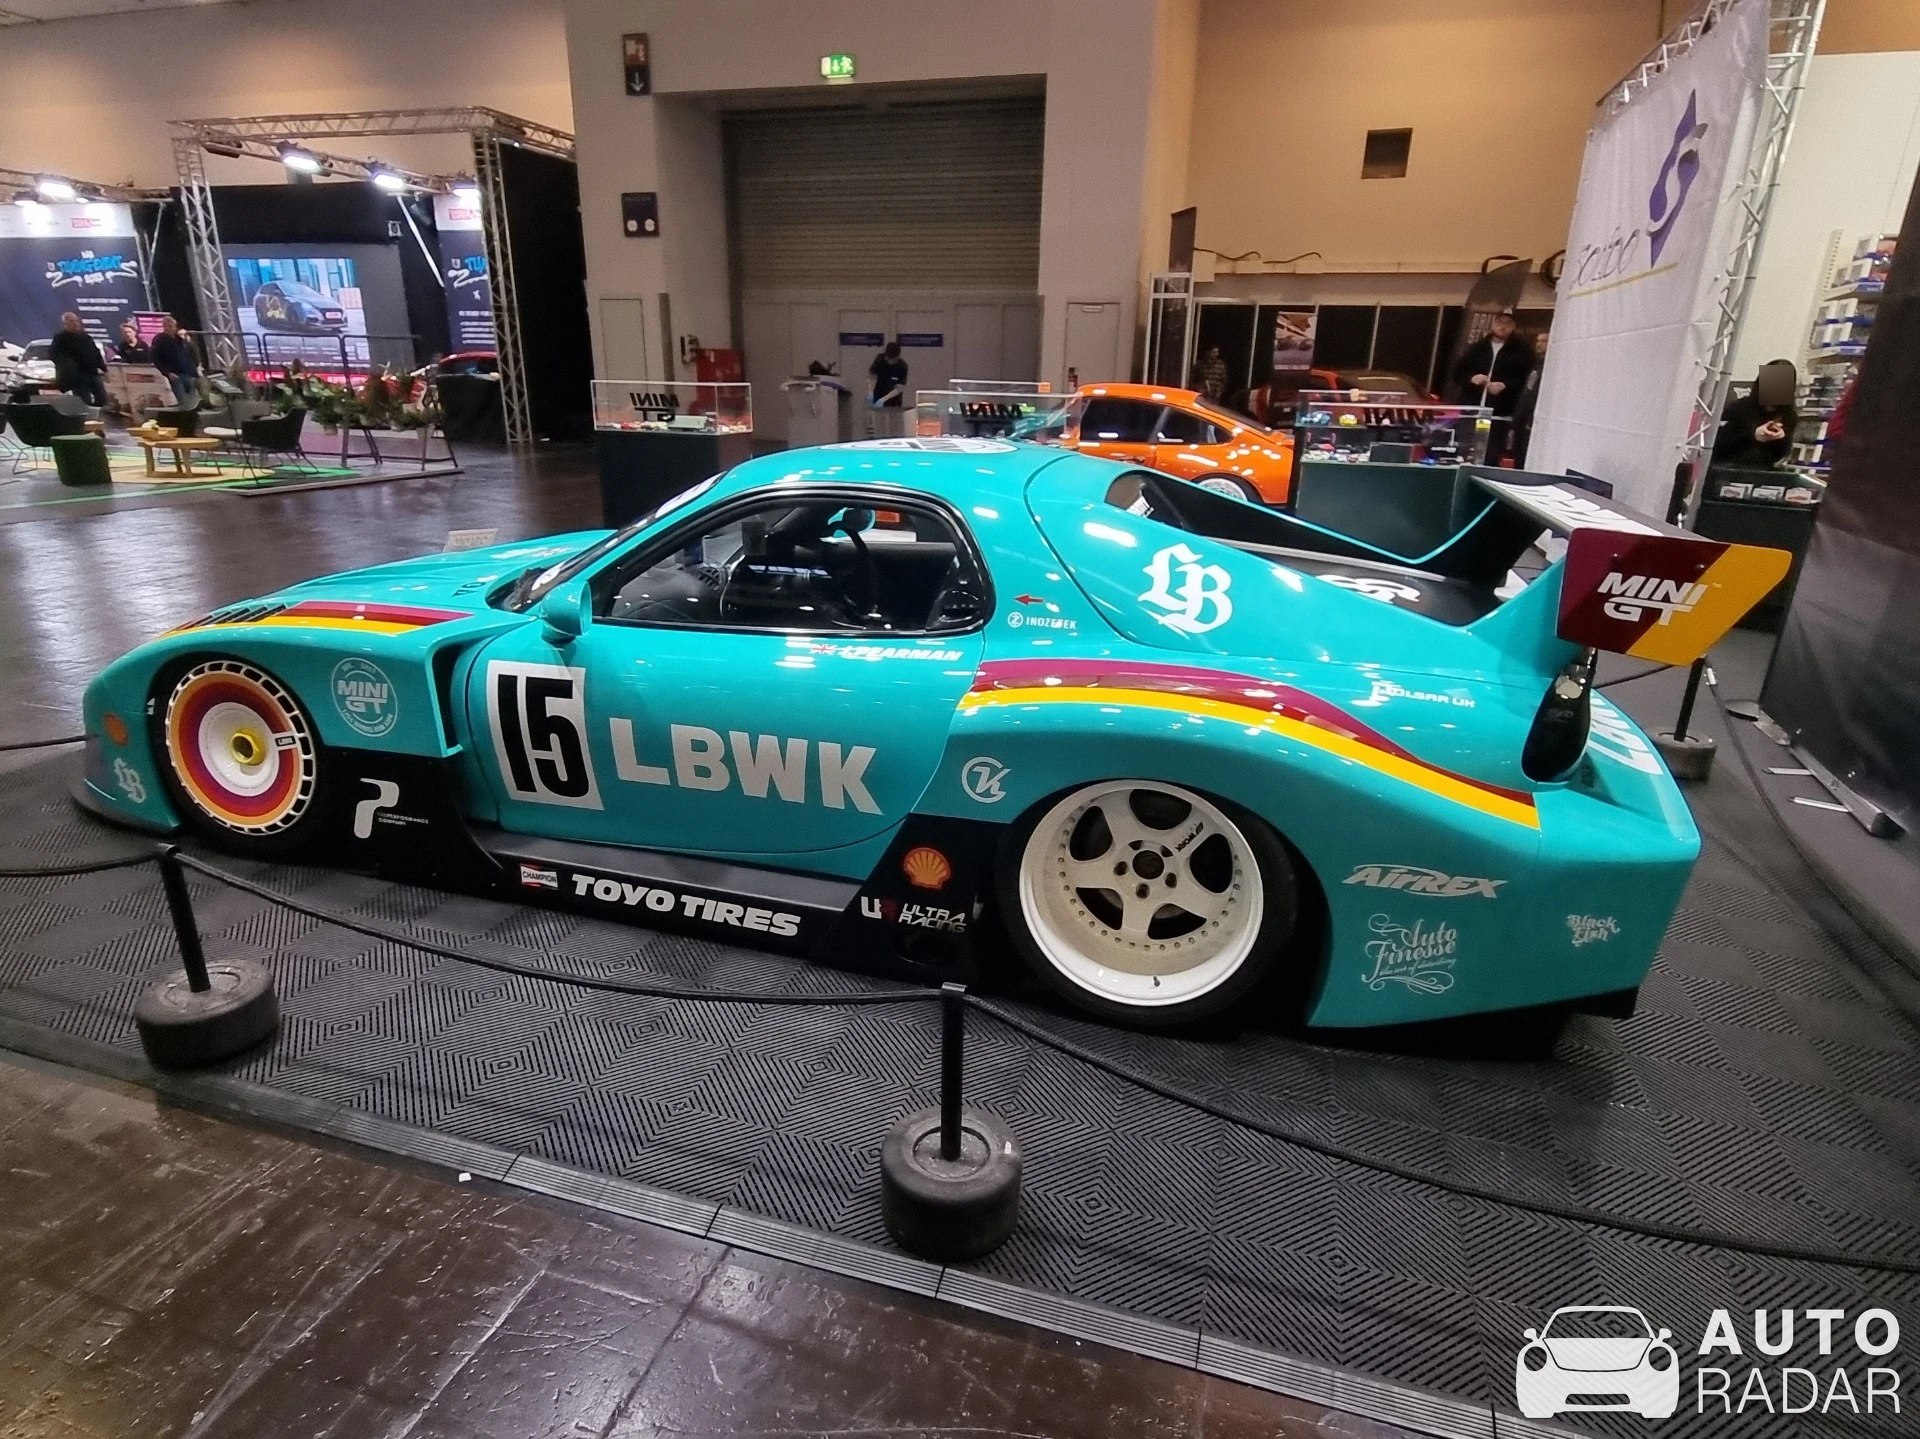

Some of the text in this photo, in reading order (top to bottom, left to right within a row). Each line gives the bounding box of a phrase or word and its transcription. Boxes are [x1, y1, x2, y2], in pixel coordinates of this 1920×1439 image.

[1597, 571, 1708, 605] MINI
[1604, 596, 1693, 625] GT
[337, 679, 389, 698] MINI
[345, 696, 387, 714] GT
[497, 673, 590, 798] 15
[609, 717, 883, 815] LBWK
[522, 870, 557, 883] CHAMPION
[572, 874, 801, 936] TOYO TIRES
[902, 903, 965, 922] ULTRA
[1363, 939, 1457, 977] Finesse
